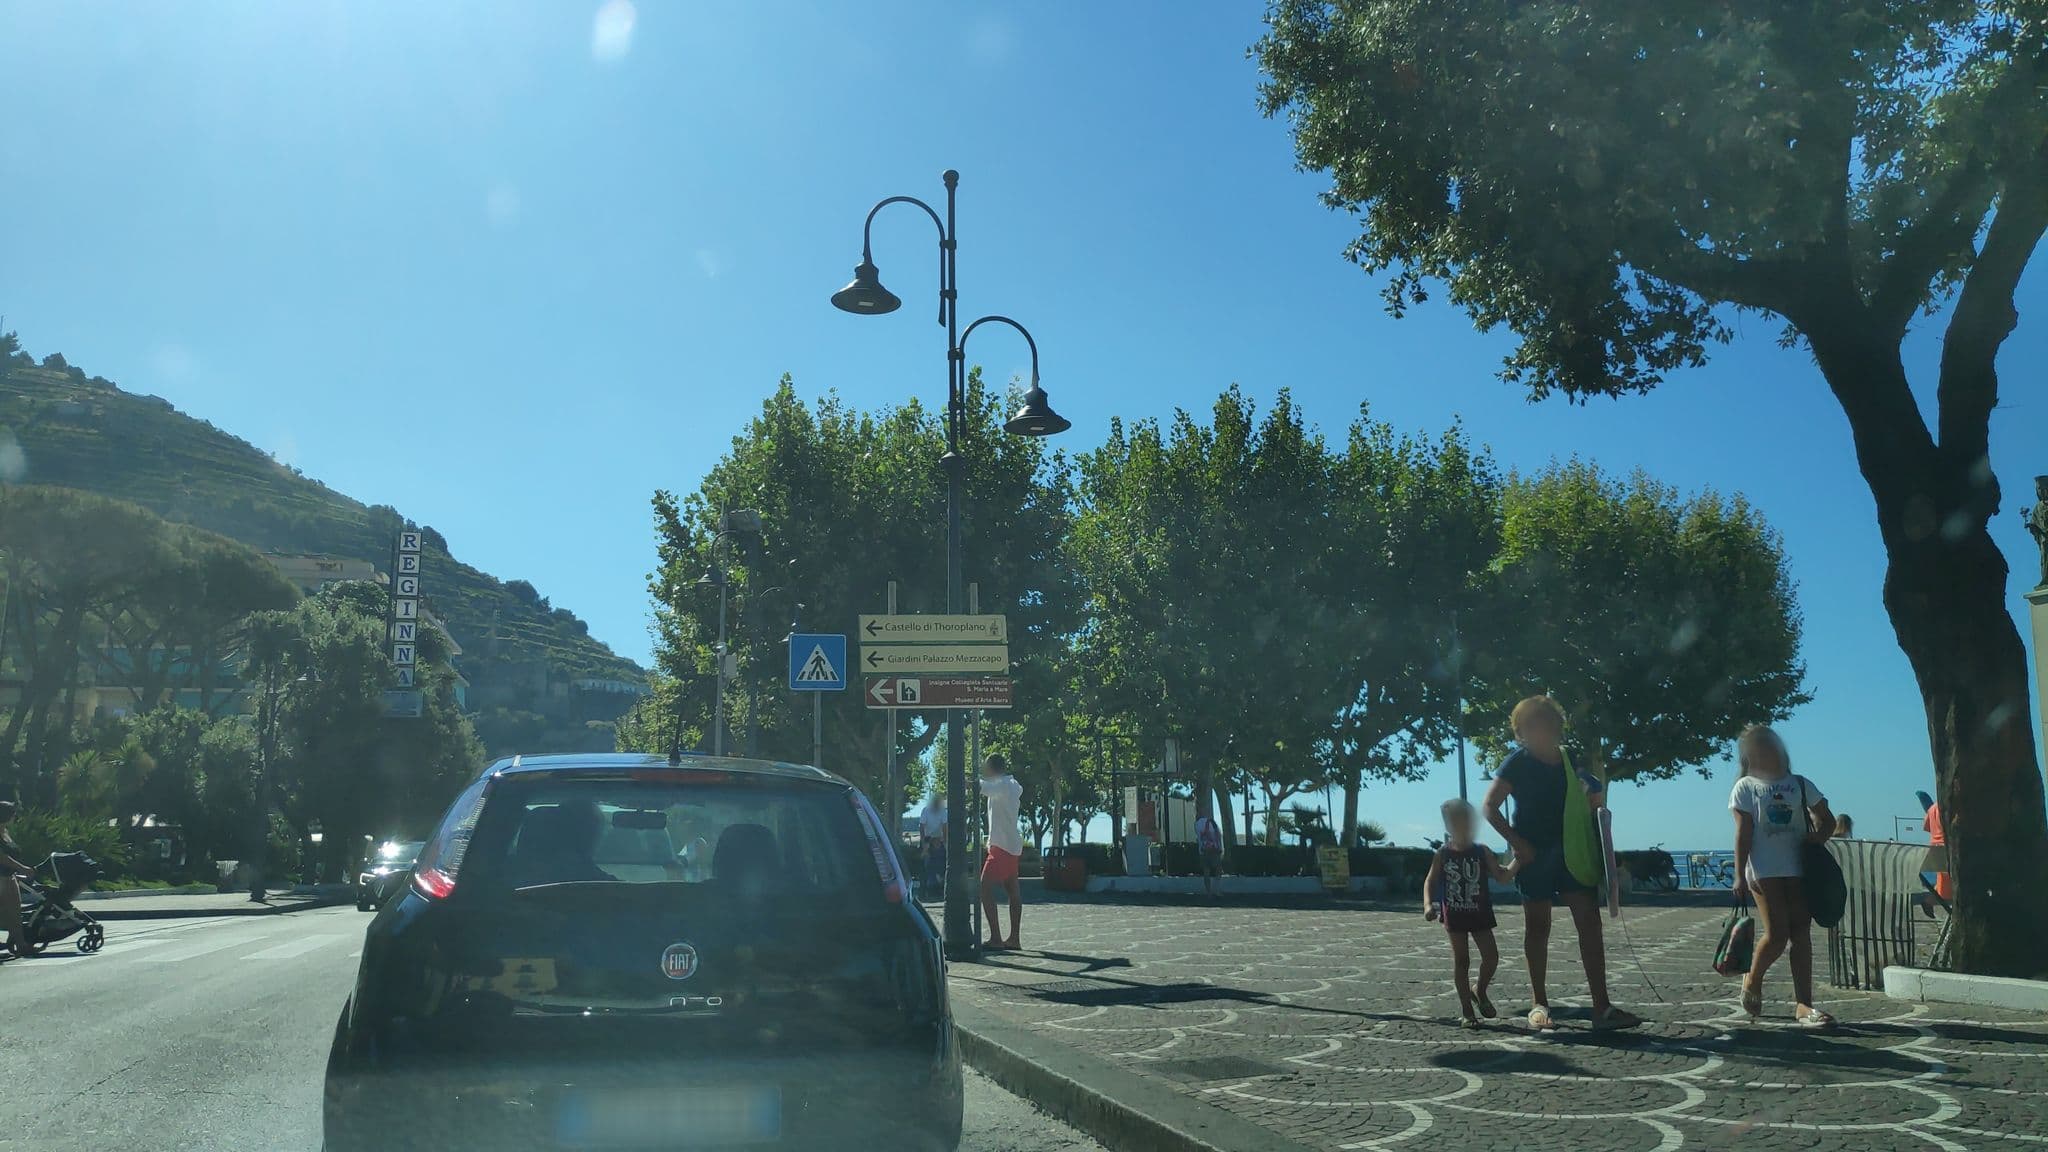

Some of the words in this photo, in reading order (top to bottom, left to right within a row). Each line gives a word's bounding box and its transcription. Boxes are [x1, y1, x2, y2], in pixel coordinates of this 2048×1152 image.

[397, 534, 418, 685] REGINNA
[885, 622, 922, 632] Castello
[923, 622, 932, 632] di
[887, 654, 921, 663] Giardini
[922, 654, 955, 663] Palazzo
[956, 655, 1002, 664] Mezzacapo
[669, 953, 690, 970] FIAT
